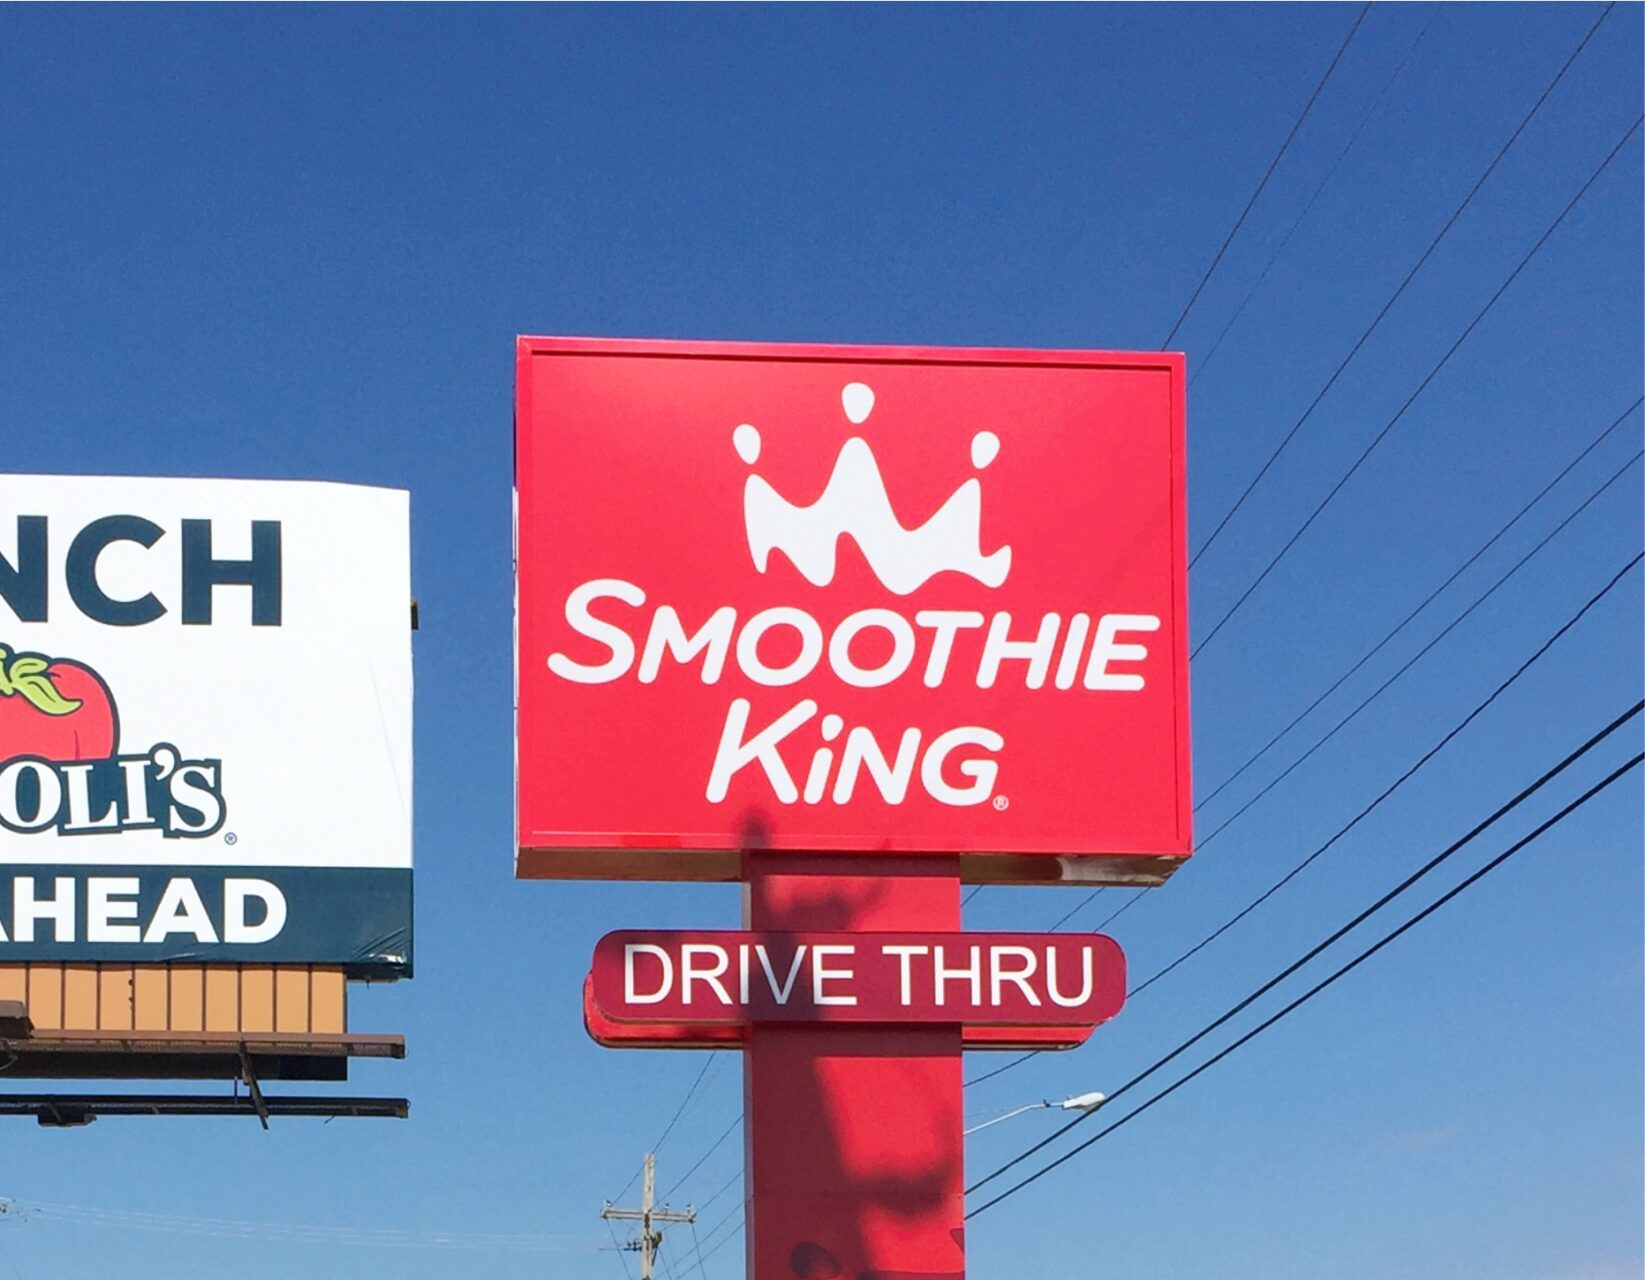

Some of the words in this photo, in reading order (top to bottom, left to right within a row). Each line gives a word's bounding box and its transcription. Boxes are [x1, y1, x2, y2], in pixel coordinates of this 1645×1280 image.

[547, 578, 1161, 692] SMOOTHIE
[0, 876, 287, 944] HEAD
[623, 942, 857, 1006] DRIVE
[882, 944, 1094, 1008] THRU
